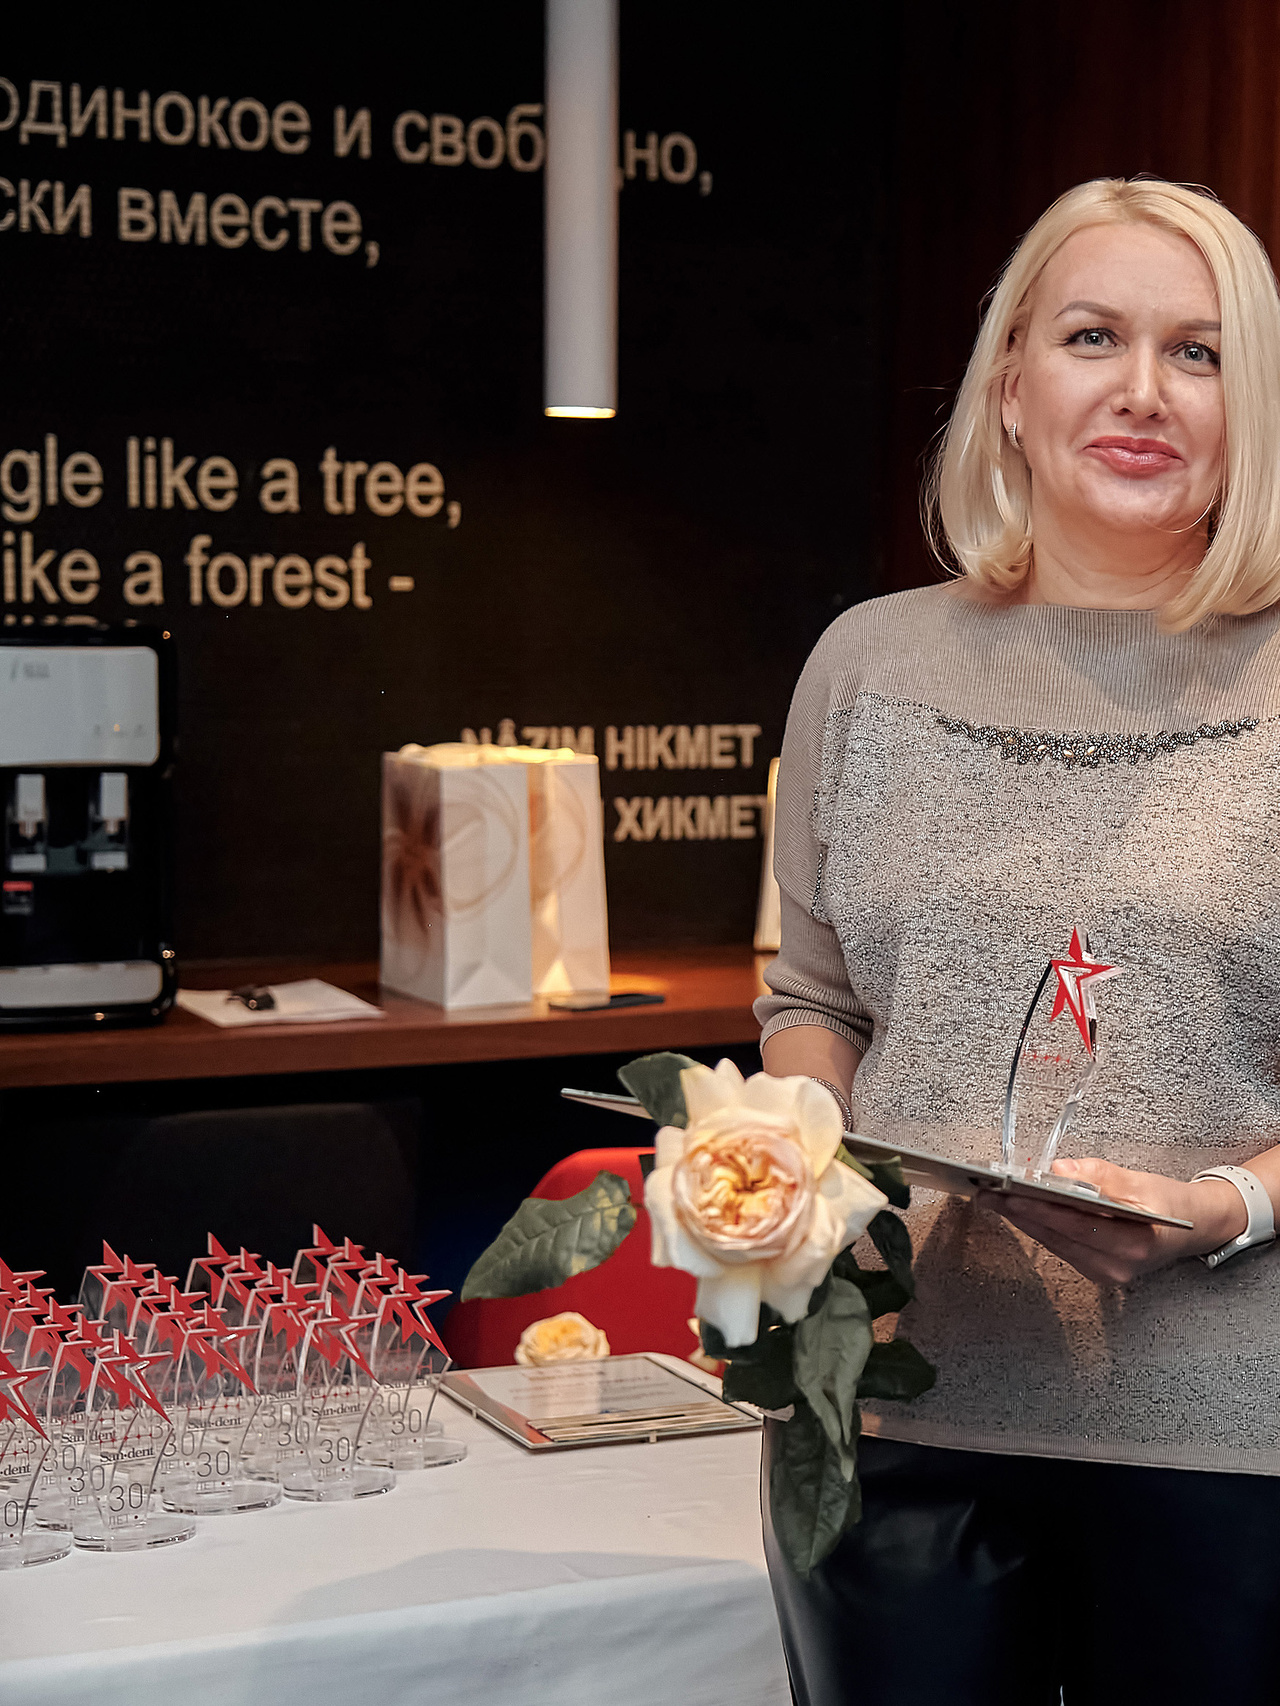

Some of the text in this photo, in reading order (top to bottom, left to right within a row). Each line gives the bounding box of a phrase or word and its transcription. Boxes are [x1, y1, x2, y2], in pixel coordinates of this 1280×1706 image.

[334, 107, 371, 158] и
[394, 104, 713, 195] свобно,
[118, 187, 380, 267] вместе,
[0, 433, 462, 528] gle like a tree,
[123, 551, 164, 605] a
[185, 534, 373, 610] forest
[605, 724, 762, 771] HIKMET
[277, 1417, 310, 1446] 30
[391, 1408, 422, 1435] 30
[196, 1450, 231, 1478] 30
[319, 1436, 350, 1464] 30
[70, 1465, 106, 1493] 30
[108, 1482, 144, 1513] 30
